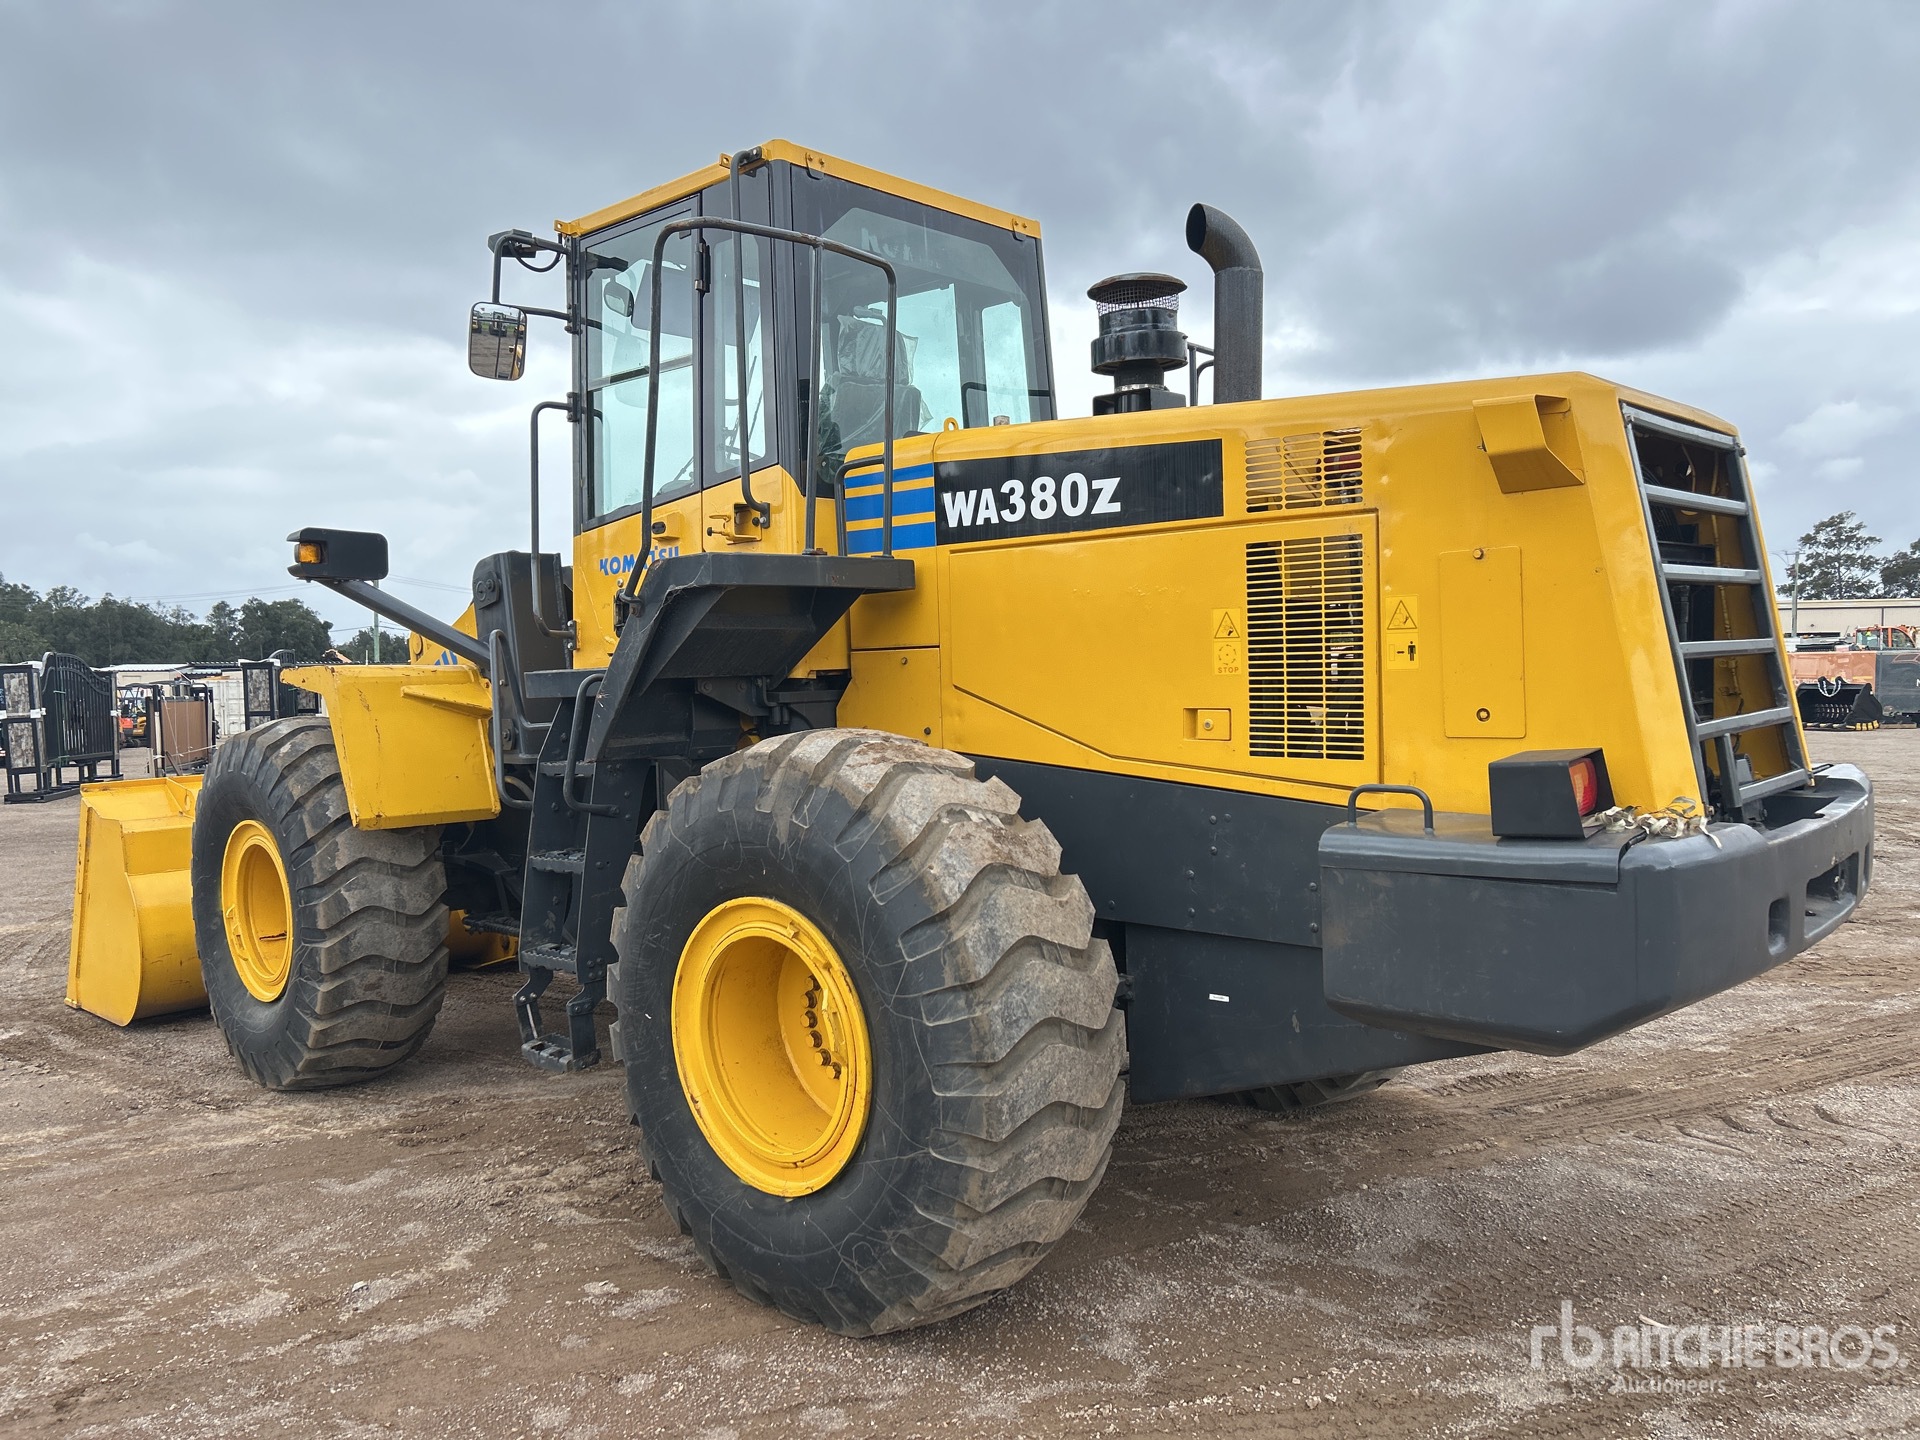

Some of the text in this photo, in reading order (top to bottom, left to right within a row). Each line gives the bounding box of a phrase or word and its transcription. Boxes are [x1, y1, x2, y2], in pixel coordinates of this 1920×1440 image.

[943, 472, 1121, 528] WA380Z
[600, 546, 679, 576] KOMTSU
[1217, 666, 1239, 674] STOP
